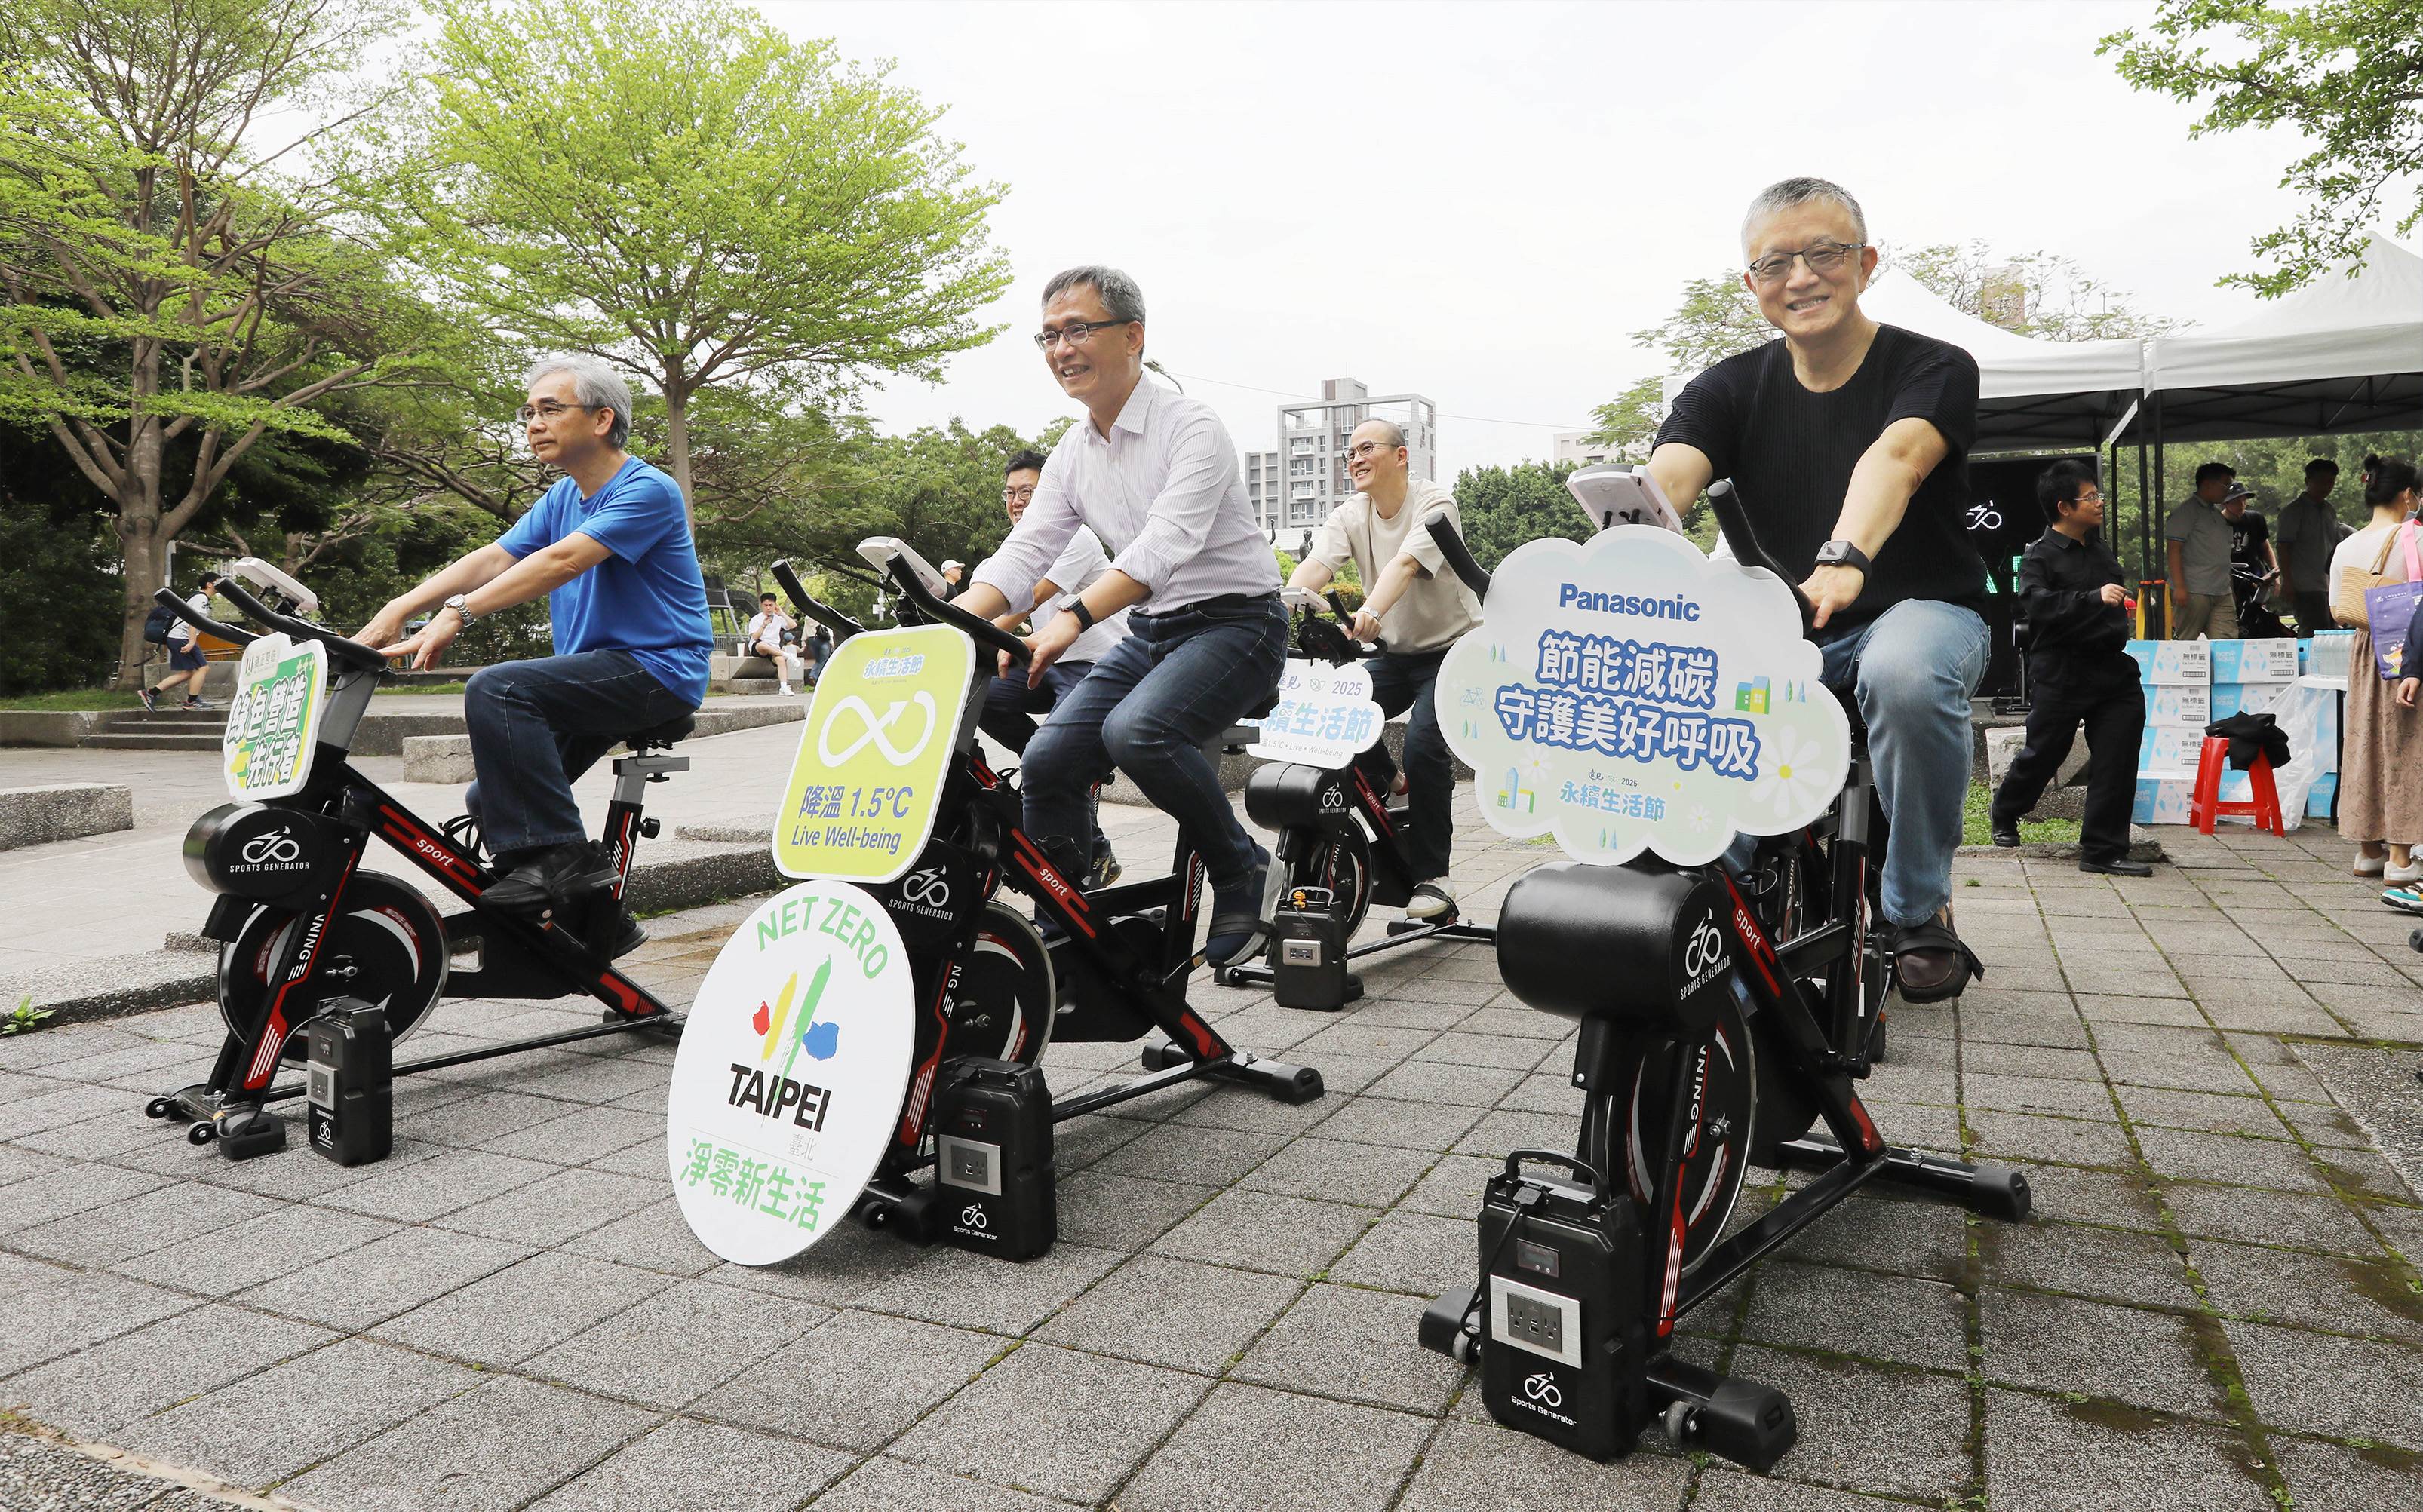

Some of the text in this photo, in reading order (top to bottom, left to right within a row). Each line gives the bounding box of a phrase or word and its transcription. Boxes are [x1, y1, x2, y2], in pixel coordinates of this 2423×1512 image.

[1559, 583, 1700, 622] Panasonic
[864, 655, 923, 677] 永續生活節
[1538, 633, 1715, 706] 節能減碳
[1331, 680, 1363, 696] 2025
[227, 671, 306, 744] 綠色營造
[1242, 700, 1375, 744] 續生活節
[1497, 687, 1758, 776] 守護美好呼吸
[246, 731, 301, 790] 先行者
[1309, 746, 1344, 759] Well-being
[1622, 777, 1638, 787] 2025
[798, 784, 846, 819] 降溫
[1367, 792, 1380, 810] sport
[1560, 780, 1666, 822] 永續生活節
[416, 839, 453, 866] sport
[792, 825, 901, 855] Live Well-being
[229, 861, 310, 873] SPORTS GENERATOR
[1040, 869, 1068, 897] sport
[889, 898, 954, 921] SPORTS GENERATOR
[757, 896, 889, 979] NET ZERO
[1736, 909, 1761, 949] sport
[947, 965, 962, 989] NG
[1680, 955, 1730, 1001] SPORTS GENERATOR
[728, 1063, 832, 1133] TAIPEI
[789, 1133, 817, 1161] 臺北
[680, 1137, 827, 1232] 淨零新生活
[954, 1225, 997, 1240] Sports Generator
[1511, 1395, 1577, 1427] Sports Generator
